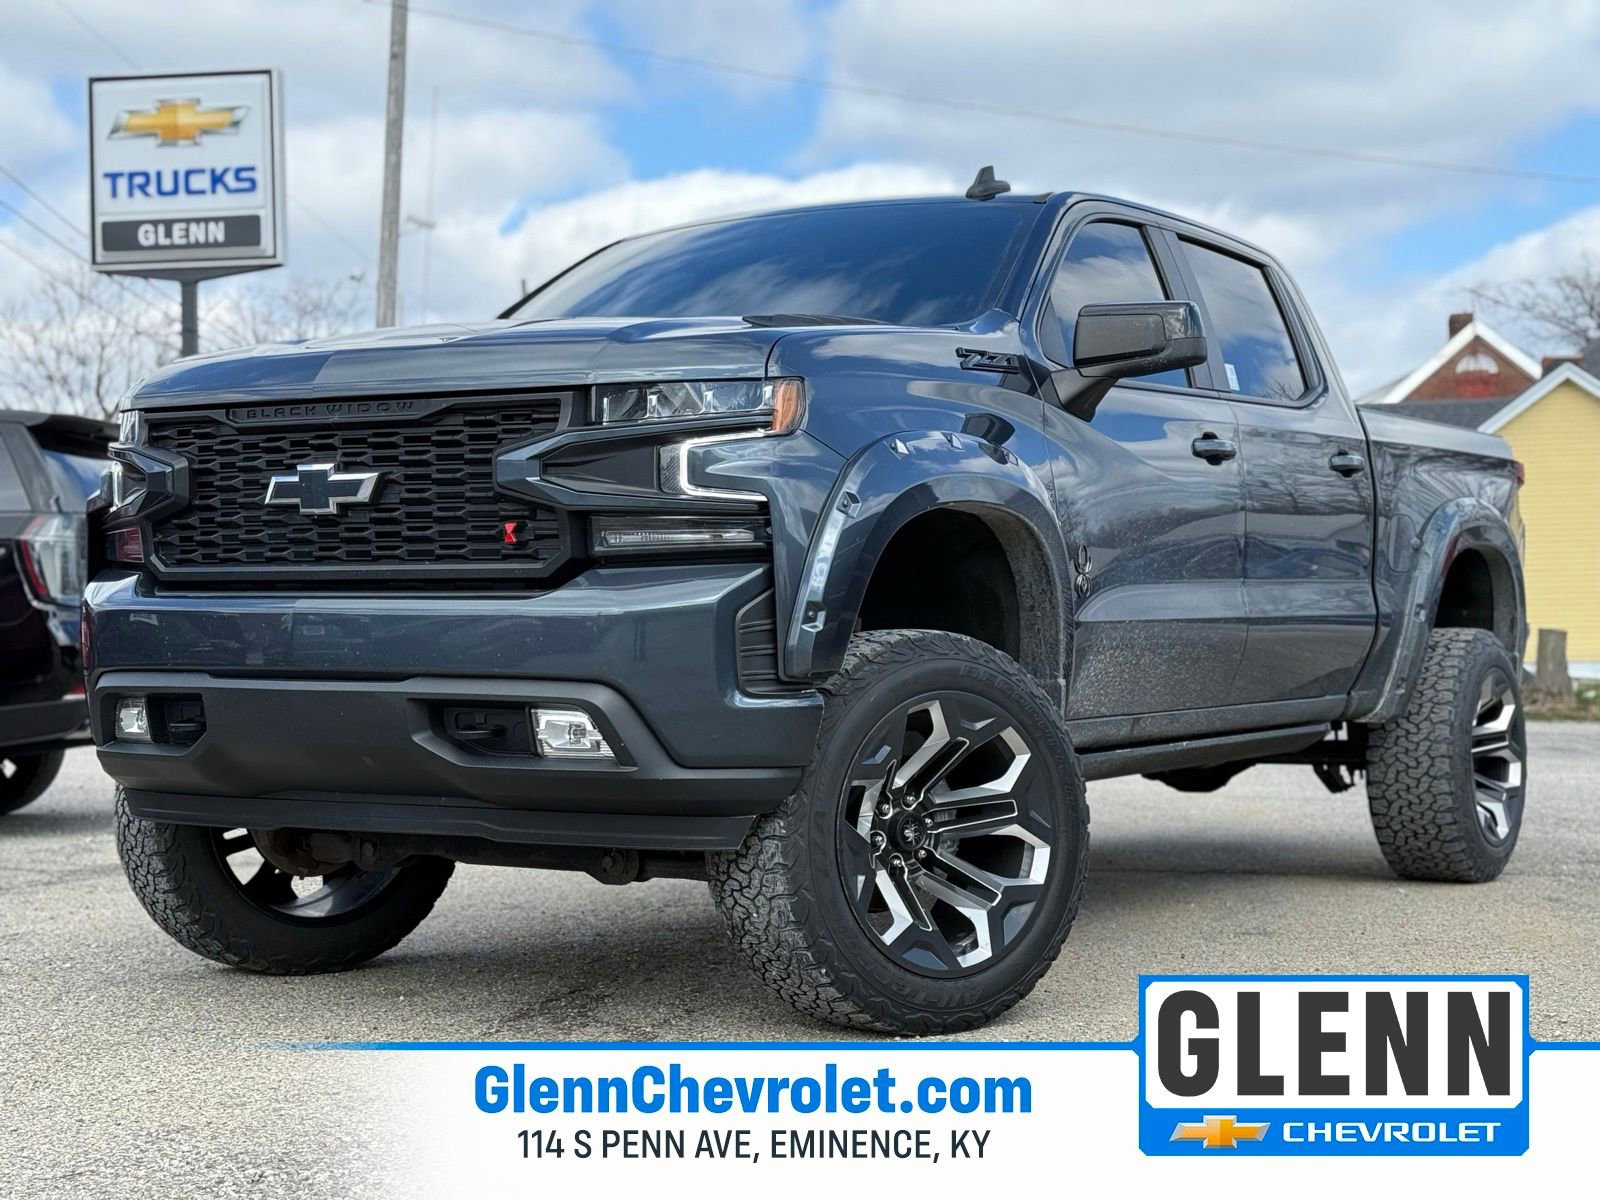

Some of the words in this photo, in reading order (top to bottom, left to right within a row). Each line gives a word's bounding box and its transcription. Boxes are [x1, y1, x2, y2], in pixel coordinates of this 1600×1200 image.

[103, 166, 257, 199] TRUCKS
[137, 221, 226, 247] GLENN
[246, 404, 317, 419] BLACK
[326, 401, 415, 415] WIDOW
